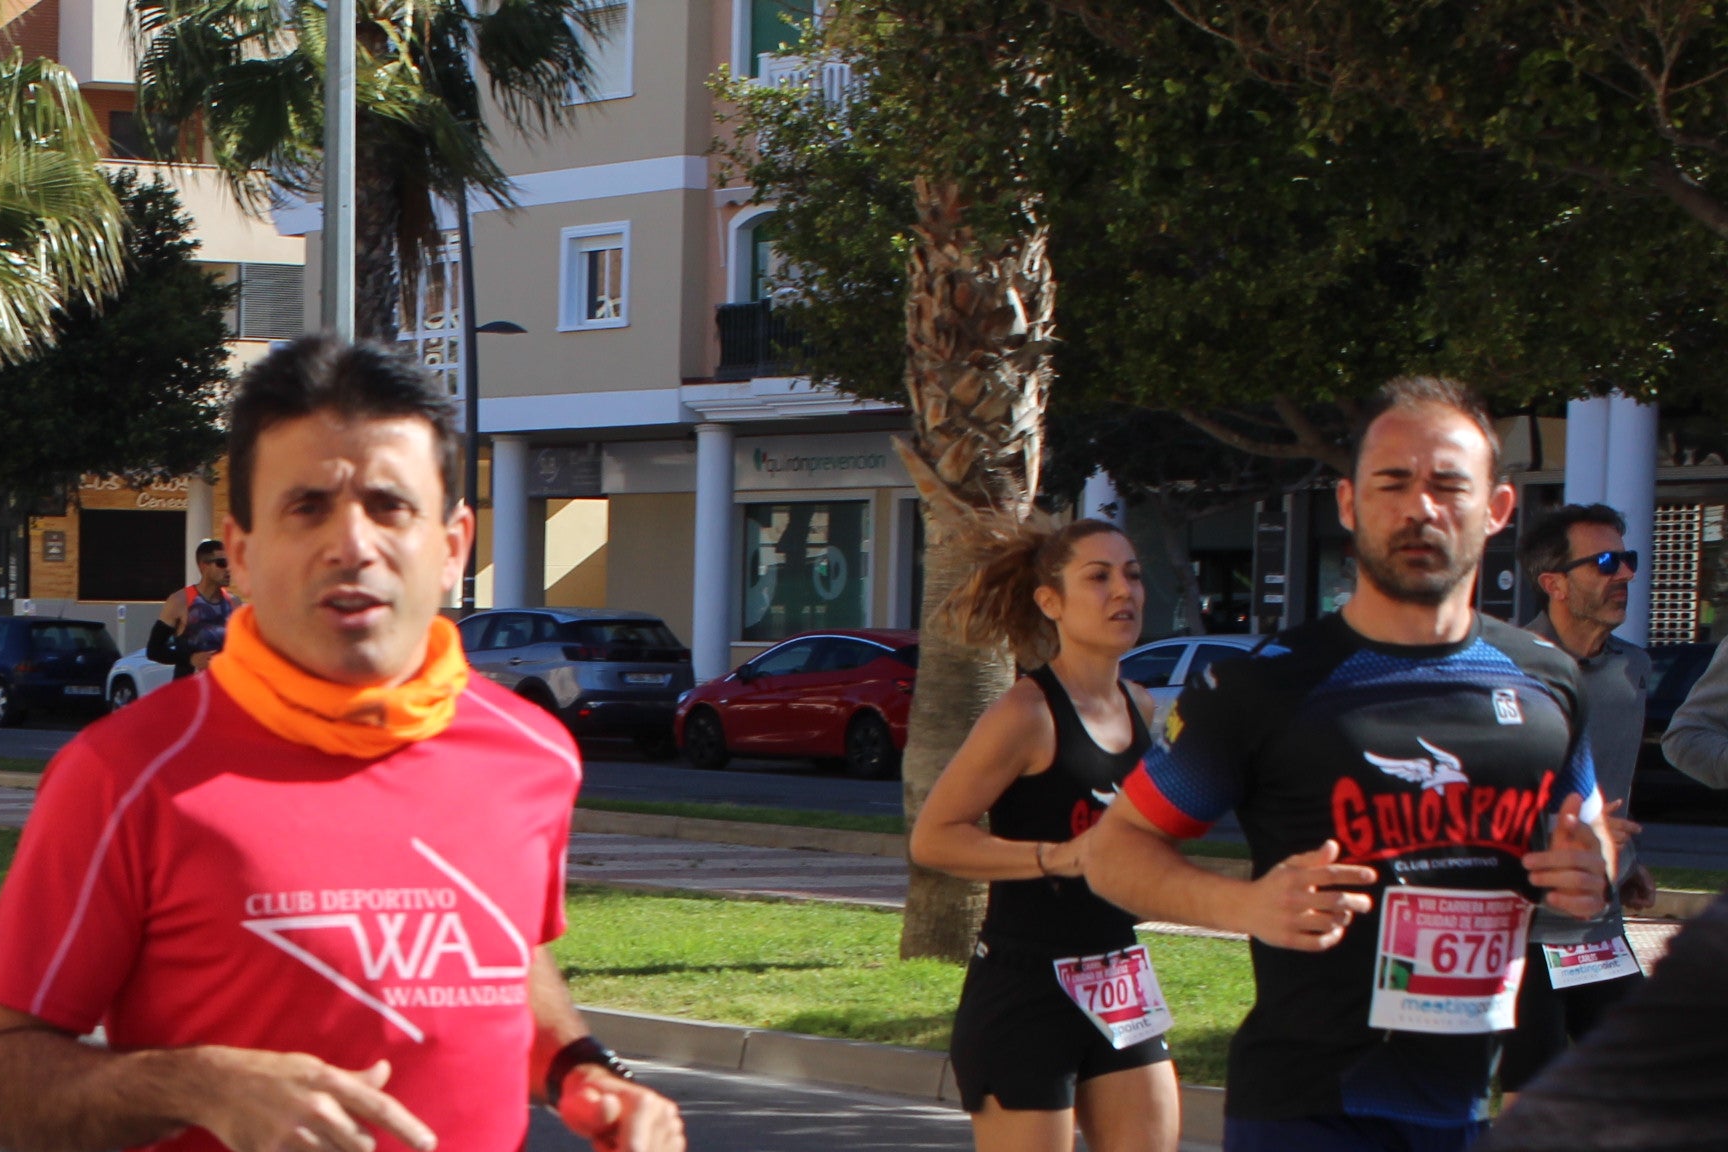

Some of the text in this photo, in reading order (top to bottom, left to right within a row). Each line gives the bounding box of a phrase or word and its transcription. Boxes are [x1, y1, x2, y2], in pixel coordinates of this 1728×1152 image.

[1393, 859, 1430, 871] CLUB
[245, 887, 458, 916] CLUB DEPORTIVO
[354, 912, 480, 981] WA
[1432, 932, 1503, 974] 676
[1083, 977, 1129, 1013] 700
